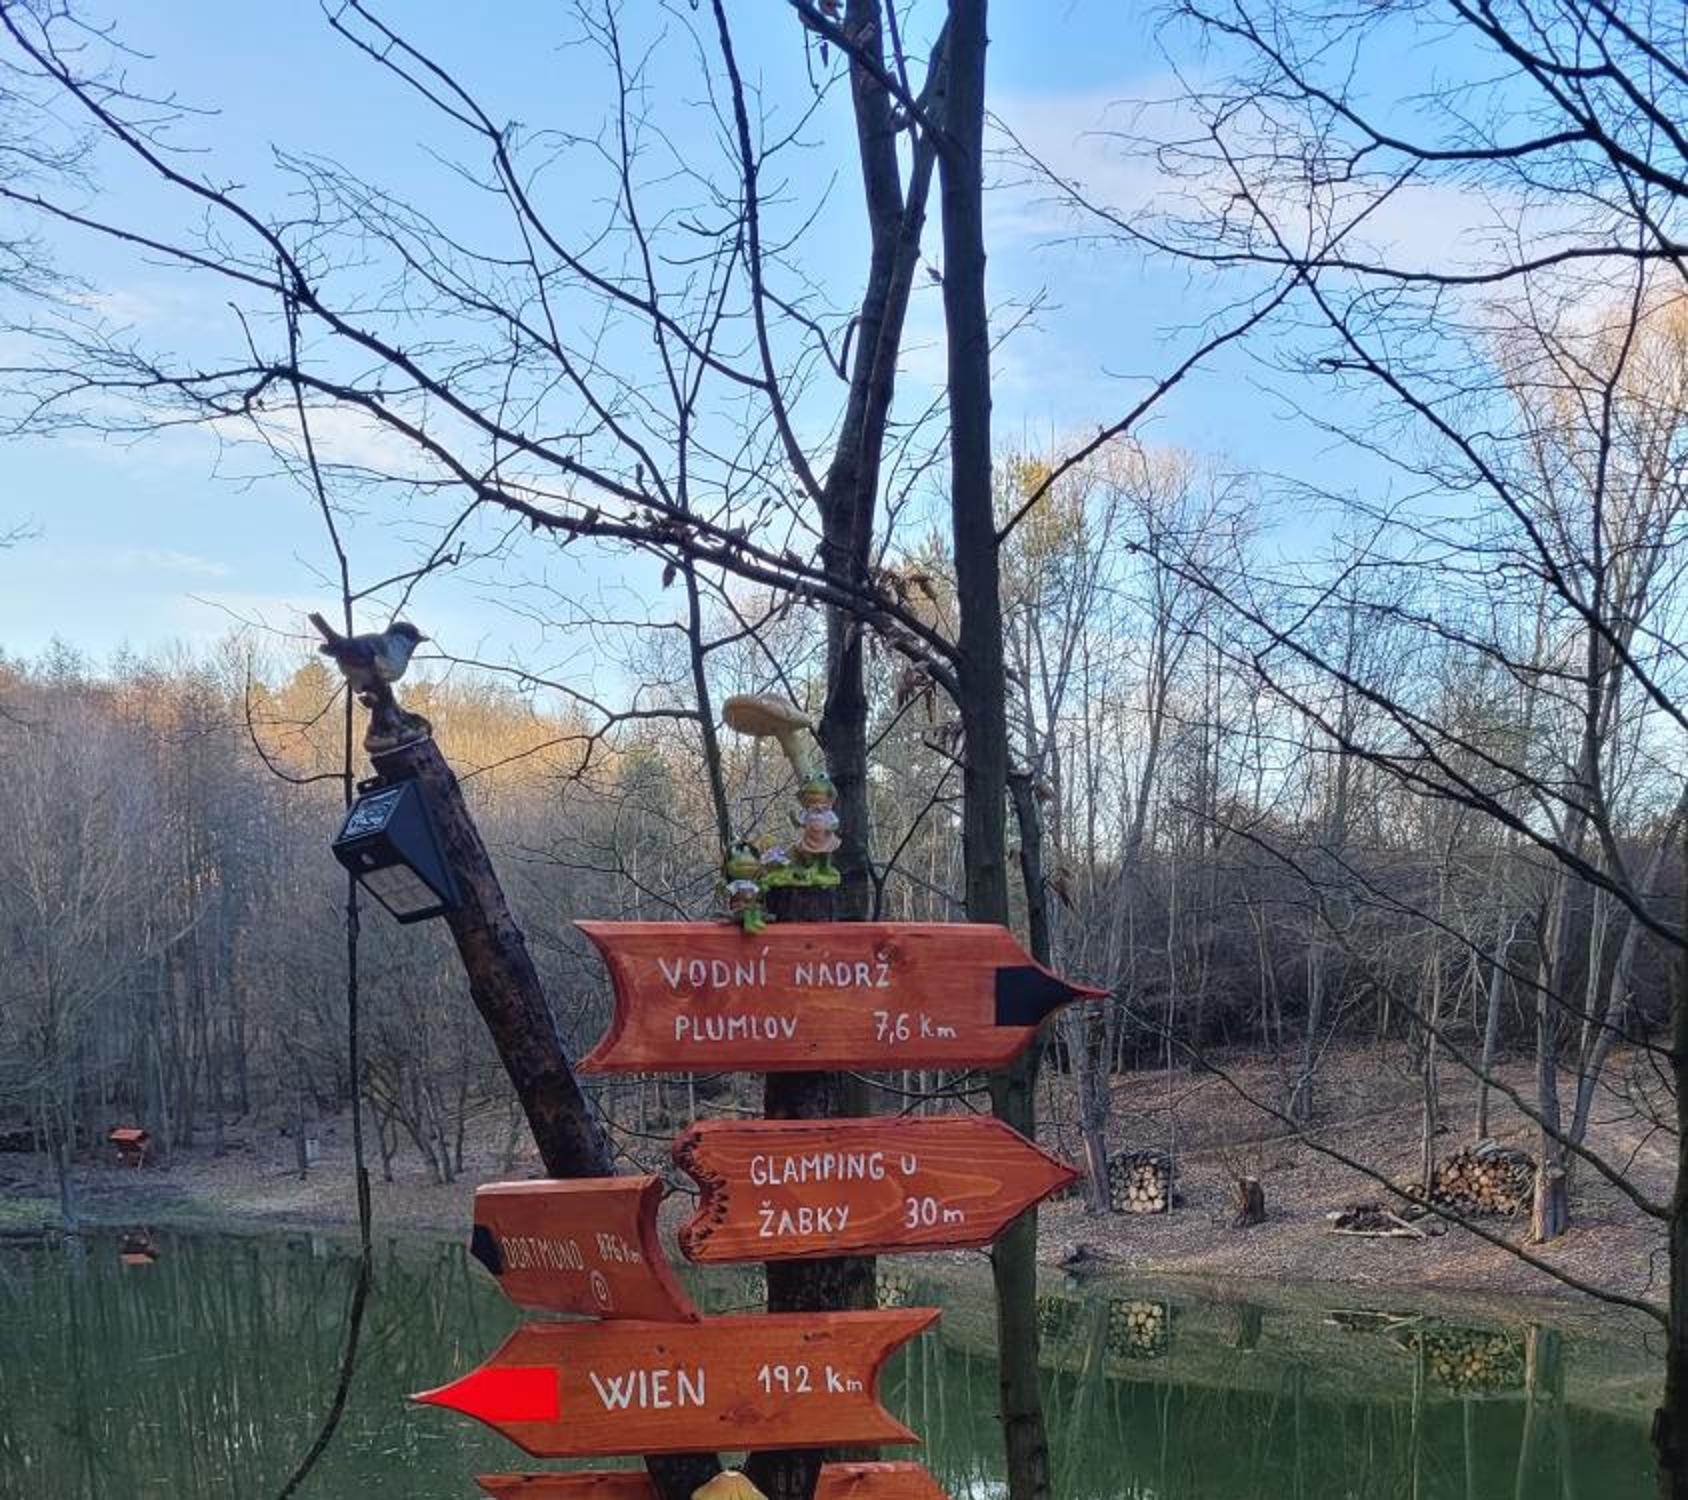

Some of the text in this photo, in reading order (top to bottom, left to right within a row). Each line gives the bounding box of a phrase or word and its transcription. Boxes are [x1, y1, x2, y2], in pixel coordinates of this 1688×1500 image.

[658, 947, 891, 990] VODNÍ NÁDRŽ
[674, 1015, 799, 1041] PLUMLOV
[874, 1011, 910, 1043] 7,6
[750, 1151, 919, 1186] GLAMPING U
[758, 1201, 850, 1238] ŽABKY
[501, 1235, 584, 1272] DORTMUND
[588, 1369, 705, 1410] WIEN
[757, 1365, 811, 1394] 192
